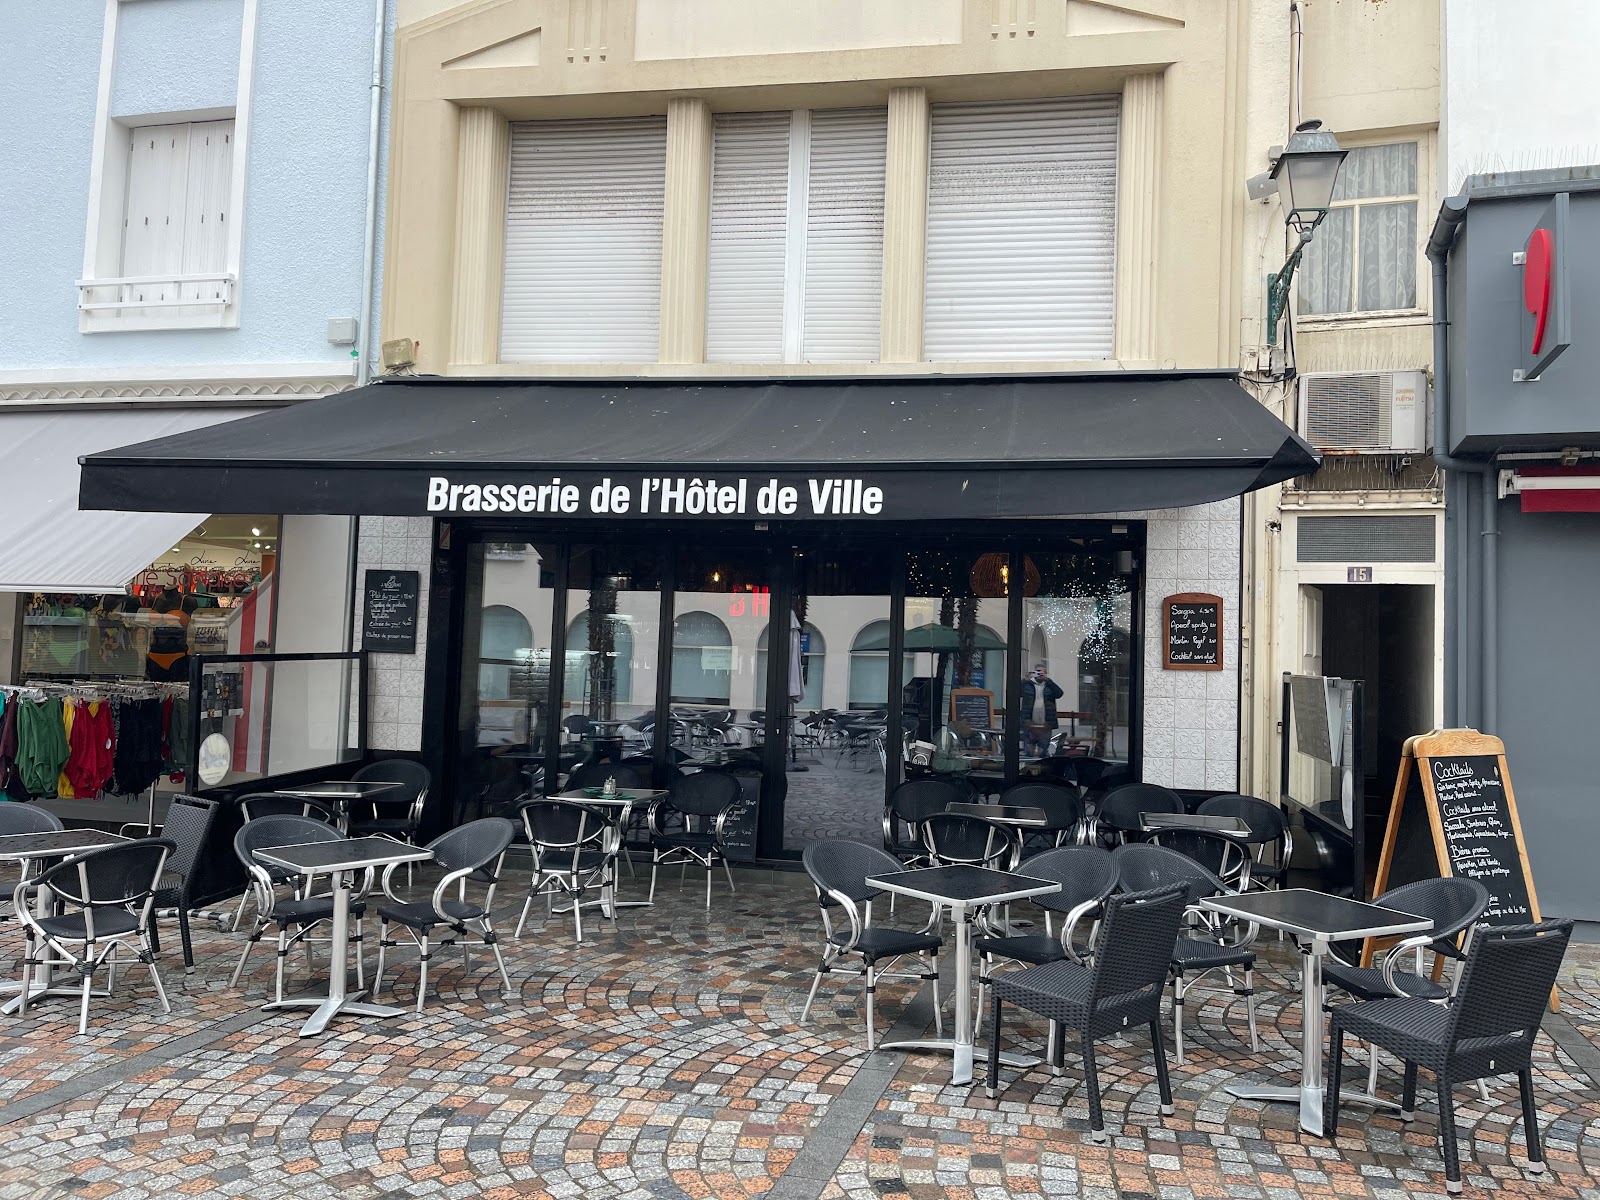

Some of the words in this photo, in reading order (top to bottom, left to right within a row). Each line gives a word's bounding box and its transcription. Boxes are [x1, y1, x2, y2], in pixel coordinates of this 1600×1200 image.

[427, 477, 580, 513] Brasserie
[590, 478, 630, 514] de
[756, 479, 798, 515] de
[808, 479, 883, 514] Ville
[1353, 568, 1367, 581] 15
[1435, 762, 1474, 779] Cocktails
